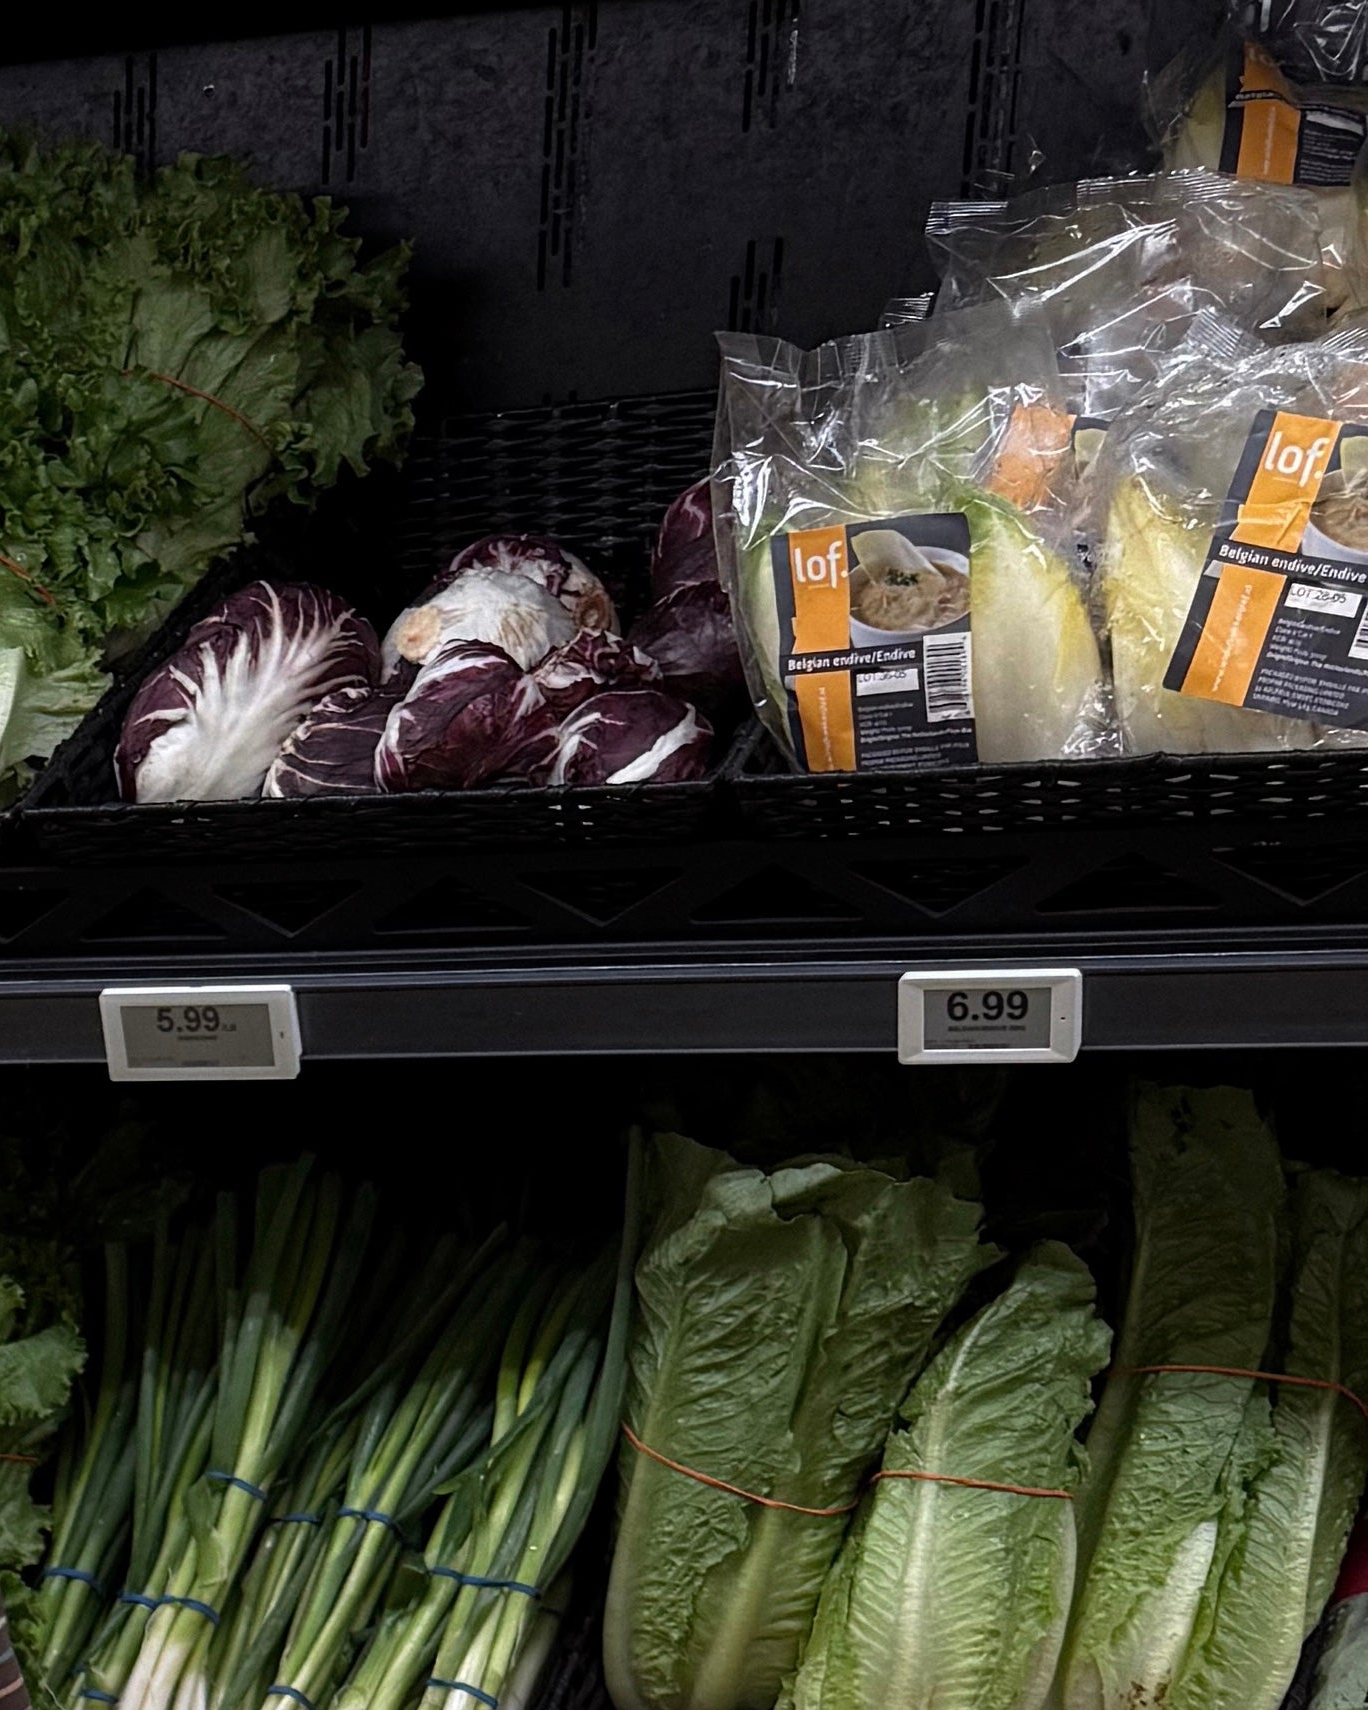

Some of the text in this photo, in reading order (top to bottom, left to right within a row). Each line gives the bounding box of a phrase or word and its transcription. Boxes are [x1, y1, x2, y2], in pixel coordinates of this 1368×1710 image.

[1264, 431, 1323, 487] lof.
[794, 541, 848, 588] lof.
[1219, 545, 1367, 585] Belgian endive/Endive
[788, 647, 916, 673] Belgian endive/Endive
[156, 1006, 220, 1032] 5.99
[947, 990, 1029, 1021] 6.99
